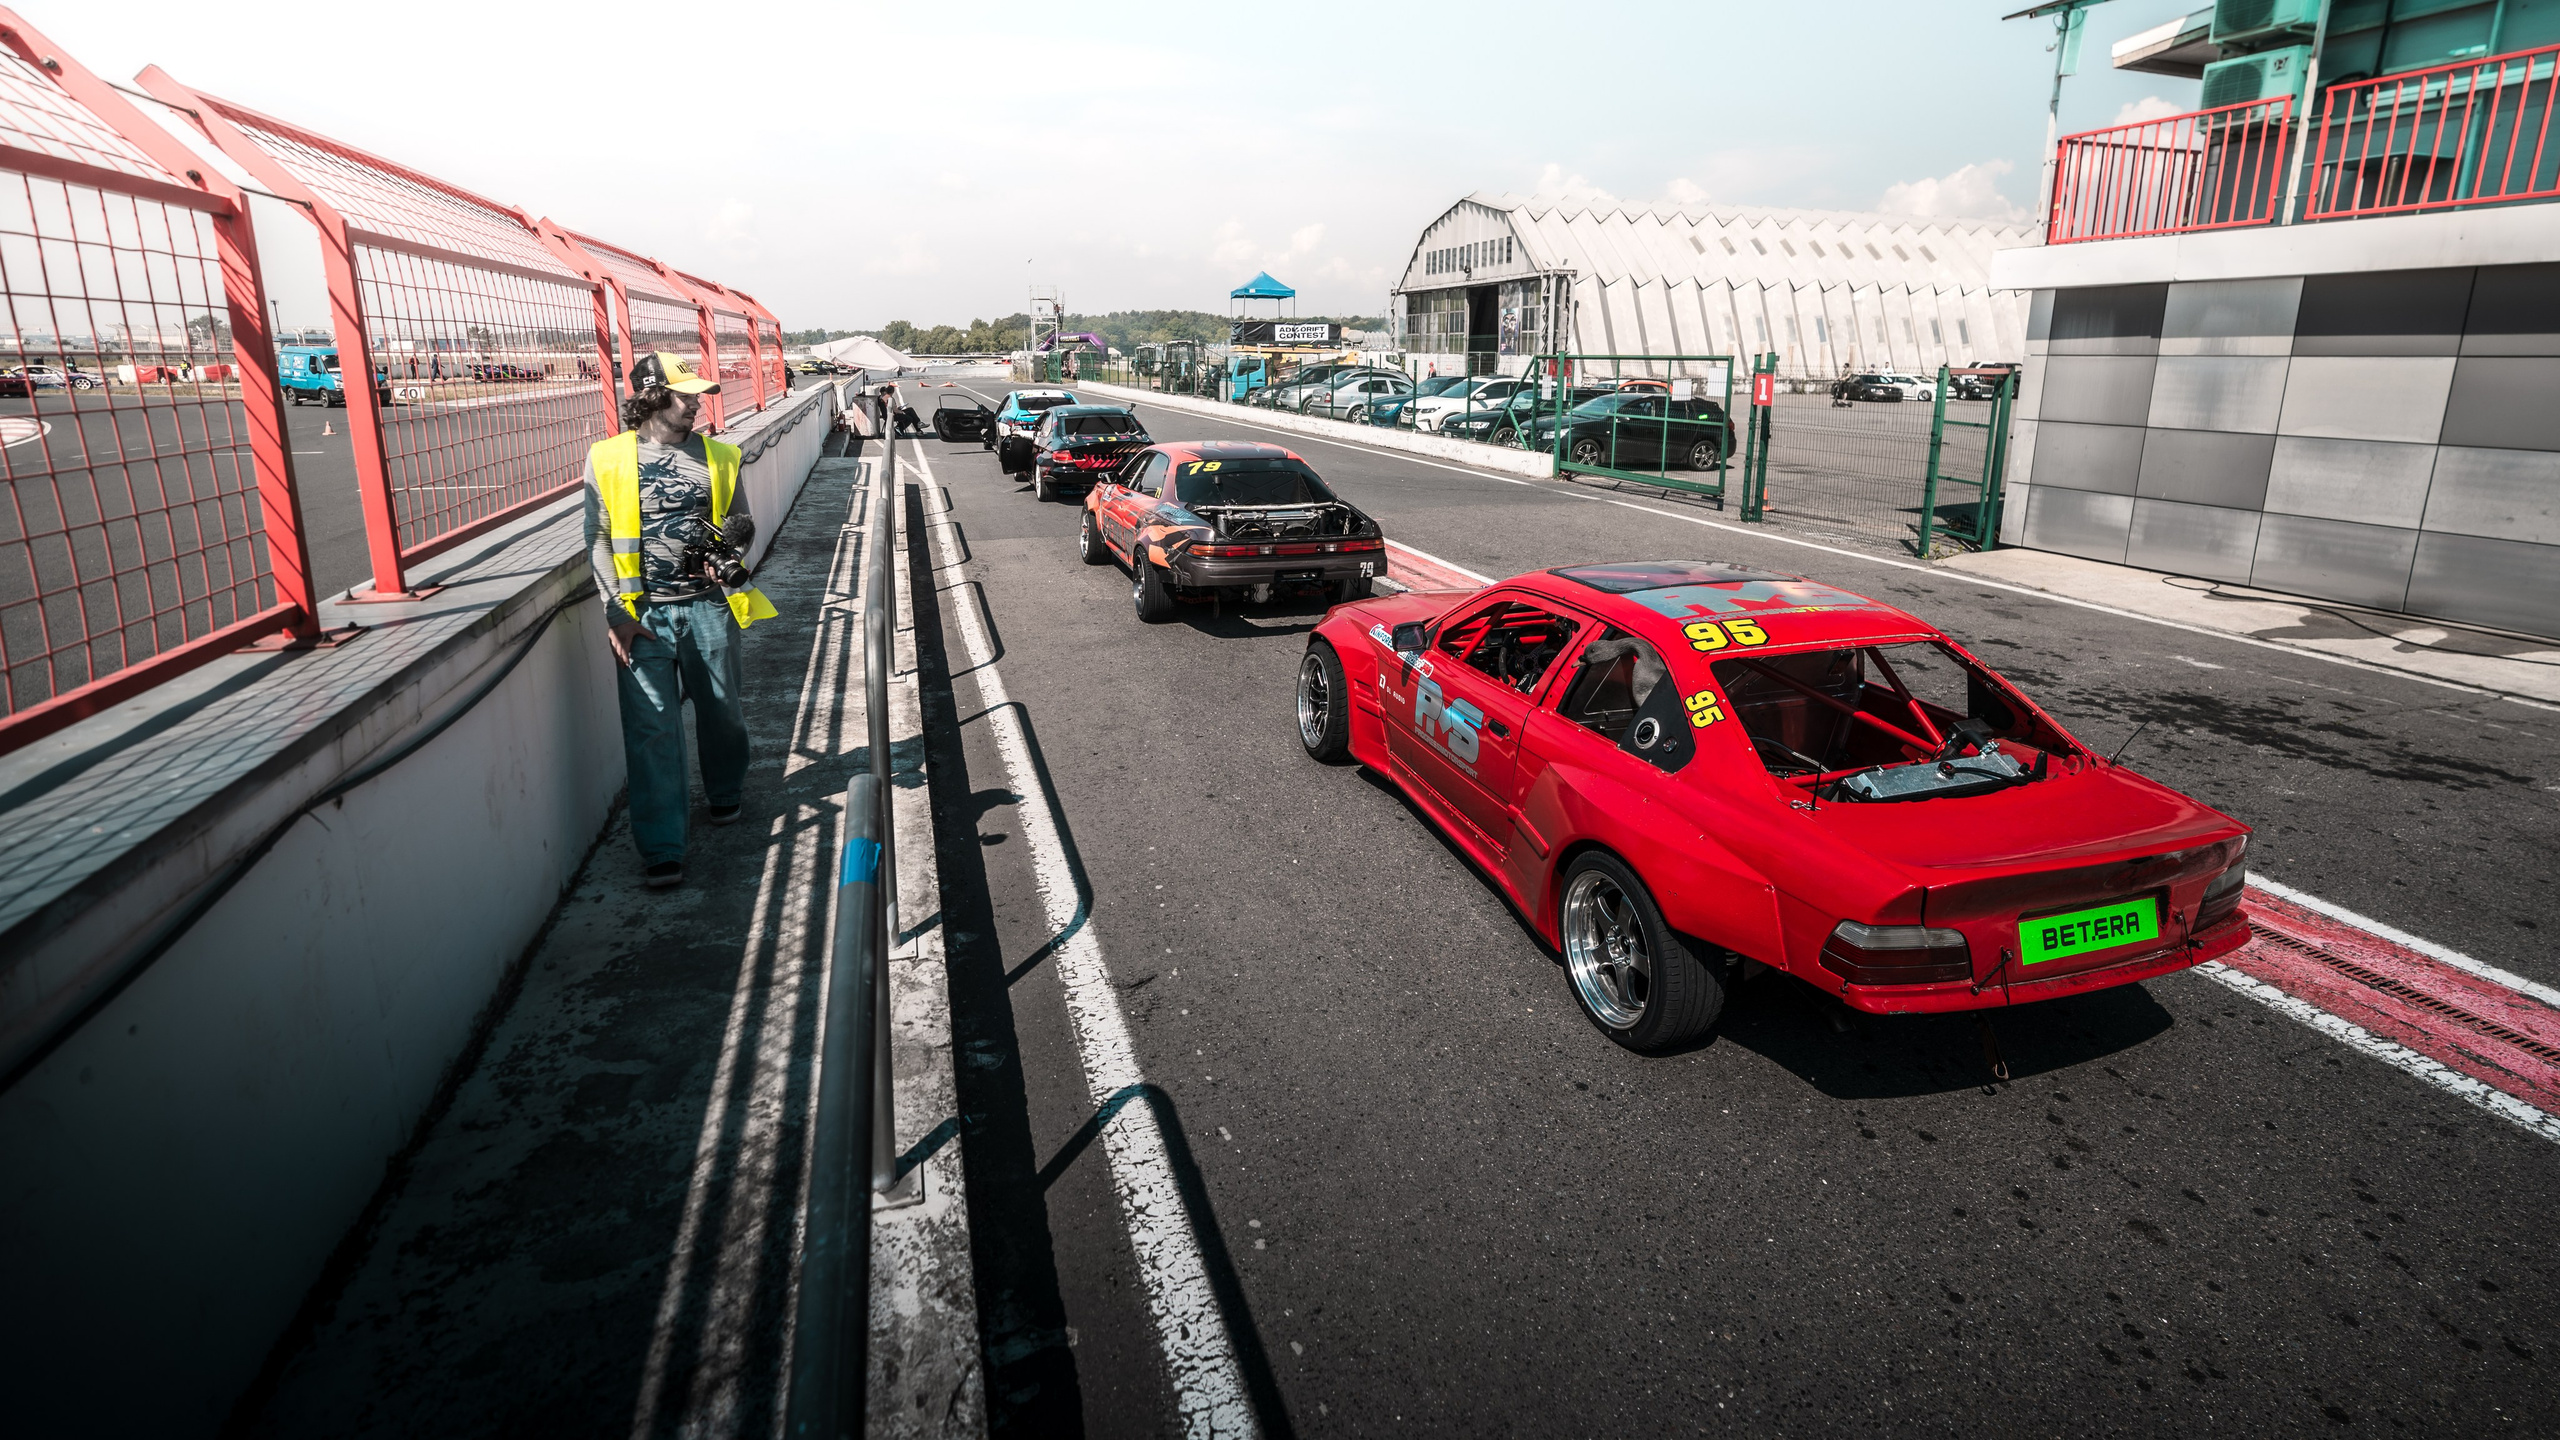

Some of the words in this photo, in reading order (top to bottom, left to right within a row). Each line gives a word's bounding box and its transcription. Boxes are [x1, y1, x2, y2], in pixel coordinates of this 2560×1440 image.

[643, 375, 656, 385] CR
[399, 388, 418, 399] 40
[1759, 378, 1768, 401] 1
[1188, 461, 1222, 476] 79
[1360, 561, 1374, 578] 79
[1681, 617, 1771, 652] 95
[1685, 690, 1726, 729] 95
